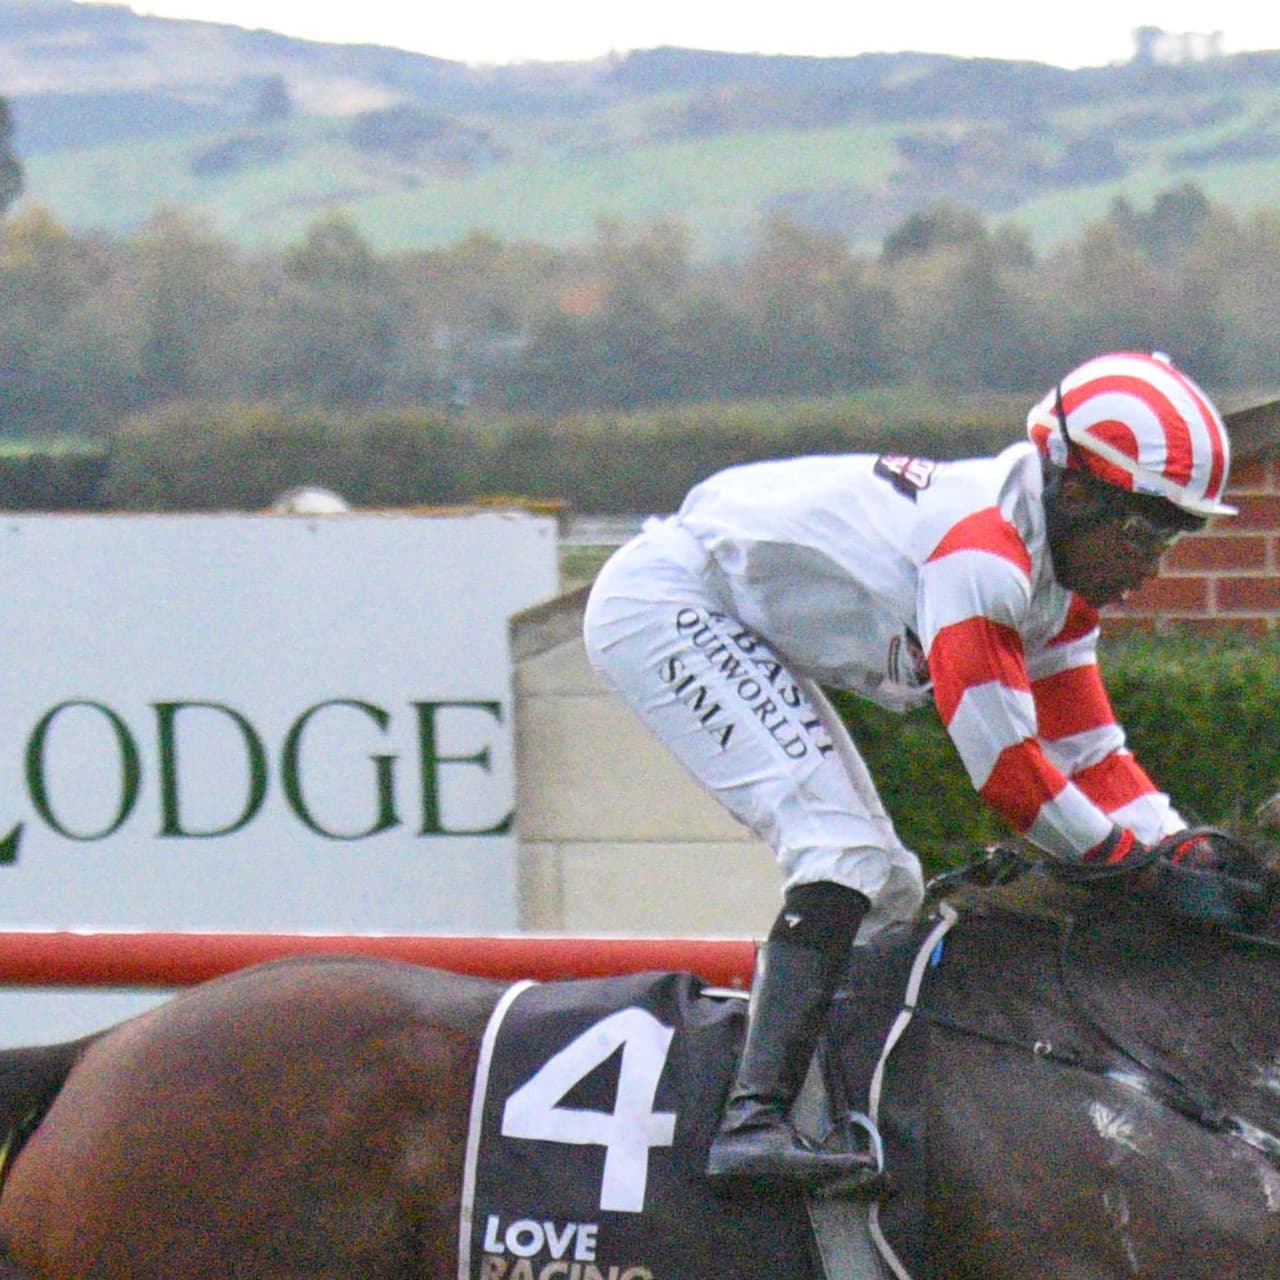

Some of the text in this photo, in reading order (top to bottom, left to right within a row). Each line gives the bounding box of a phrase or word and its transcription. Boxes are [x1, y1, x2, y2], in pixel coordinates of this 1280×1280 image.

[658, 656, 736, 752] SIMA
[0, 698, 516, 866] ODGE
[501, 1005, 677, 1213] 4
[484, 1214, 599, 1262] LOVE
